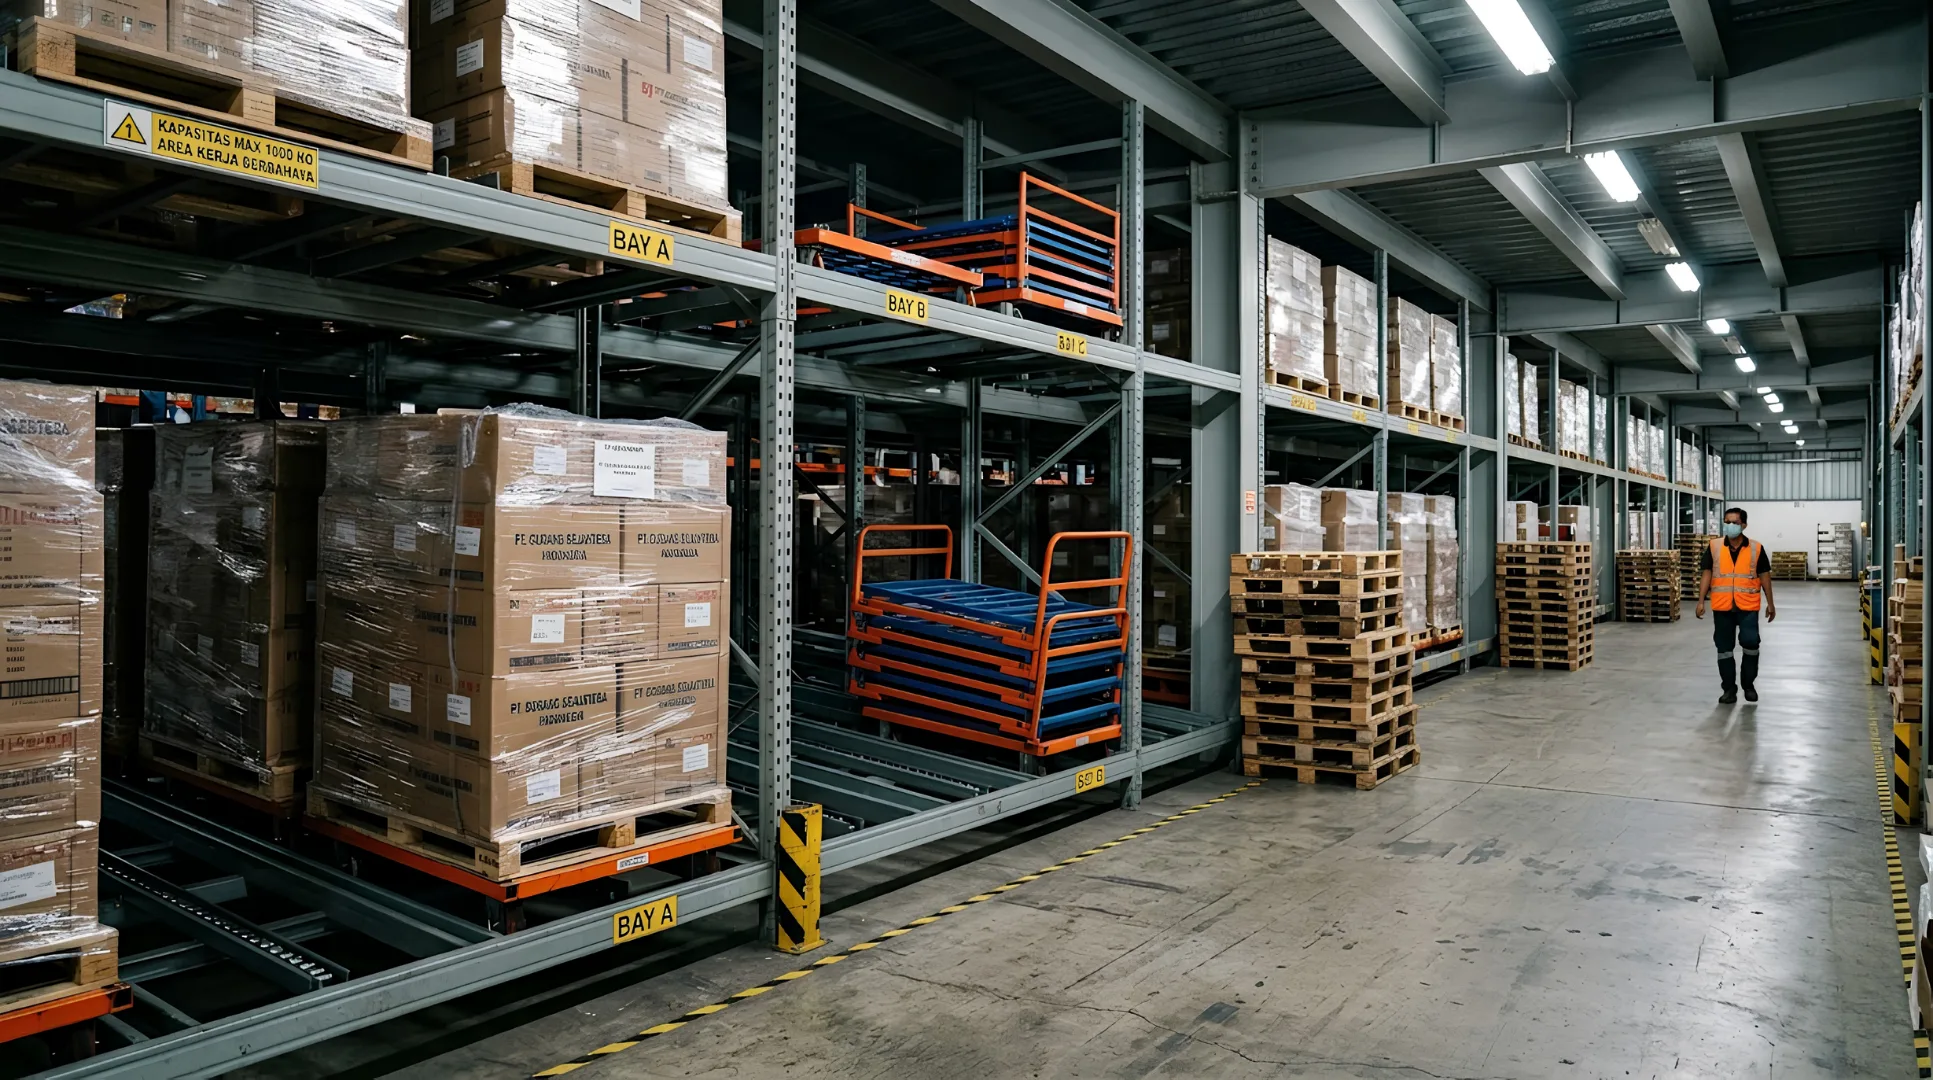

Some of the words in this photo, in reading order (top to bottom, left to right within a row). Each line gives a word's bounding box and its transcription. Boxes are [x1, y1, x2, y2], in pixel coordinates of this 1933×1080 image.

[157, 138, 193, 156] AREA
[197, 146, 239, 166] KERJA
[158, 119, 230, 146] KAPASITAS
[234, 137, 261, 154] MAX
[266, 144, 293, 161] 1000
[614, 229, 651, 256] BAY
[656, 238, 670, 260] A
[888, 294, 915, 315] BAY
[618, 907, 655, 938] BAY
[660, 903, 673, 925] A
